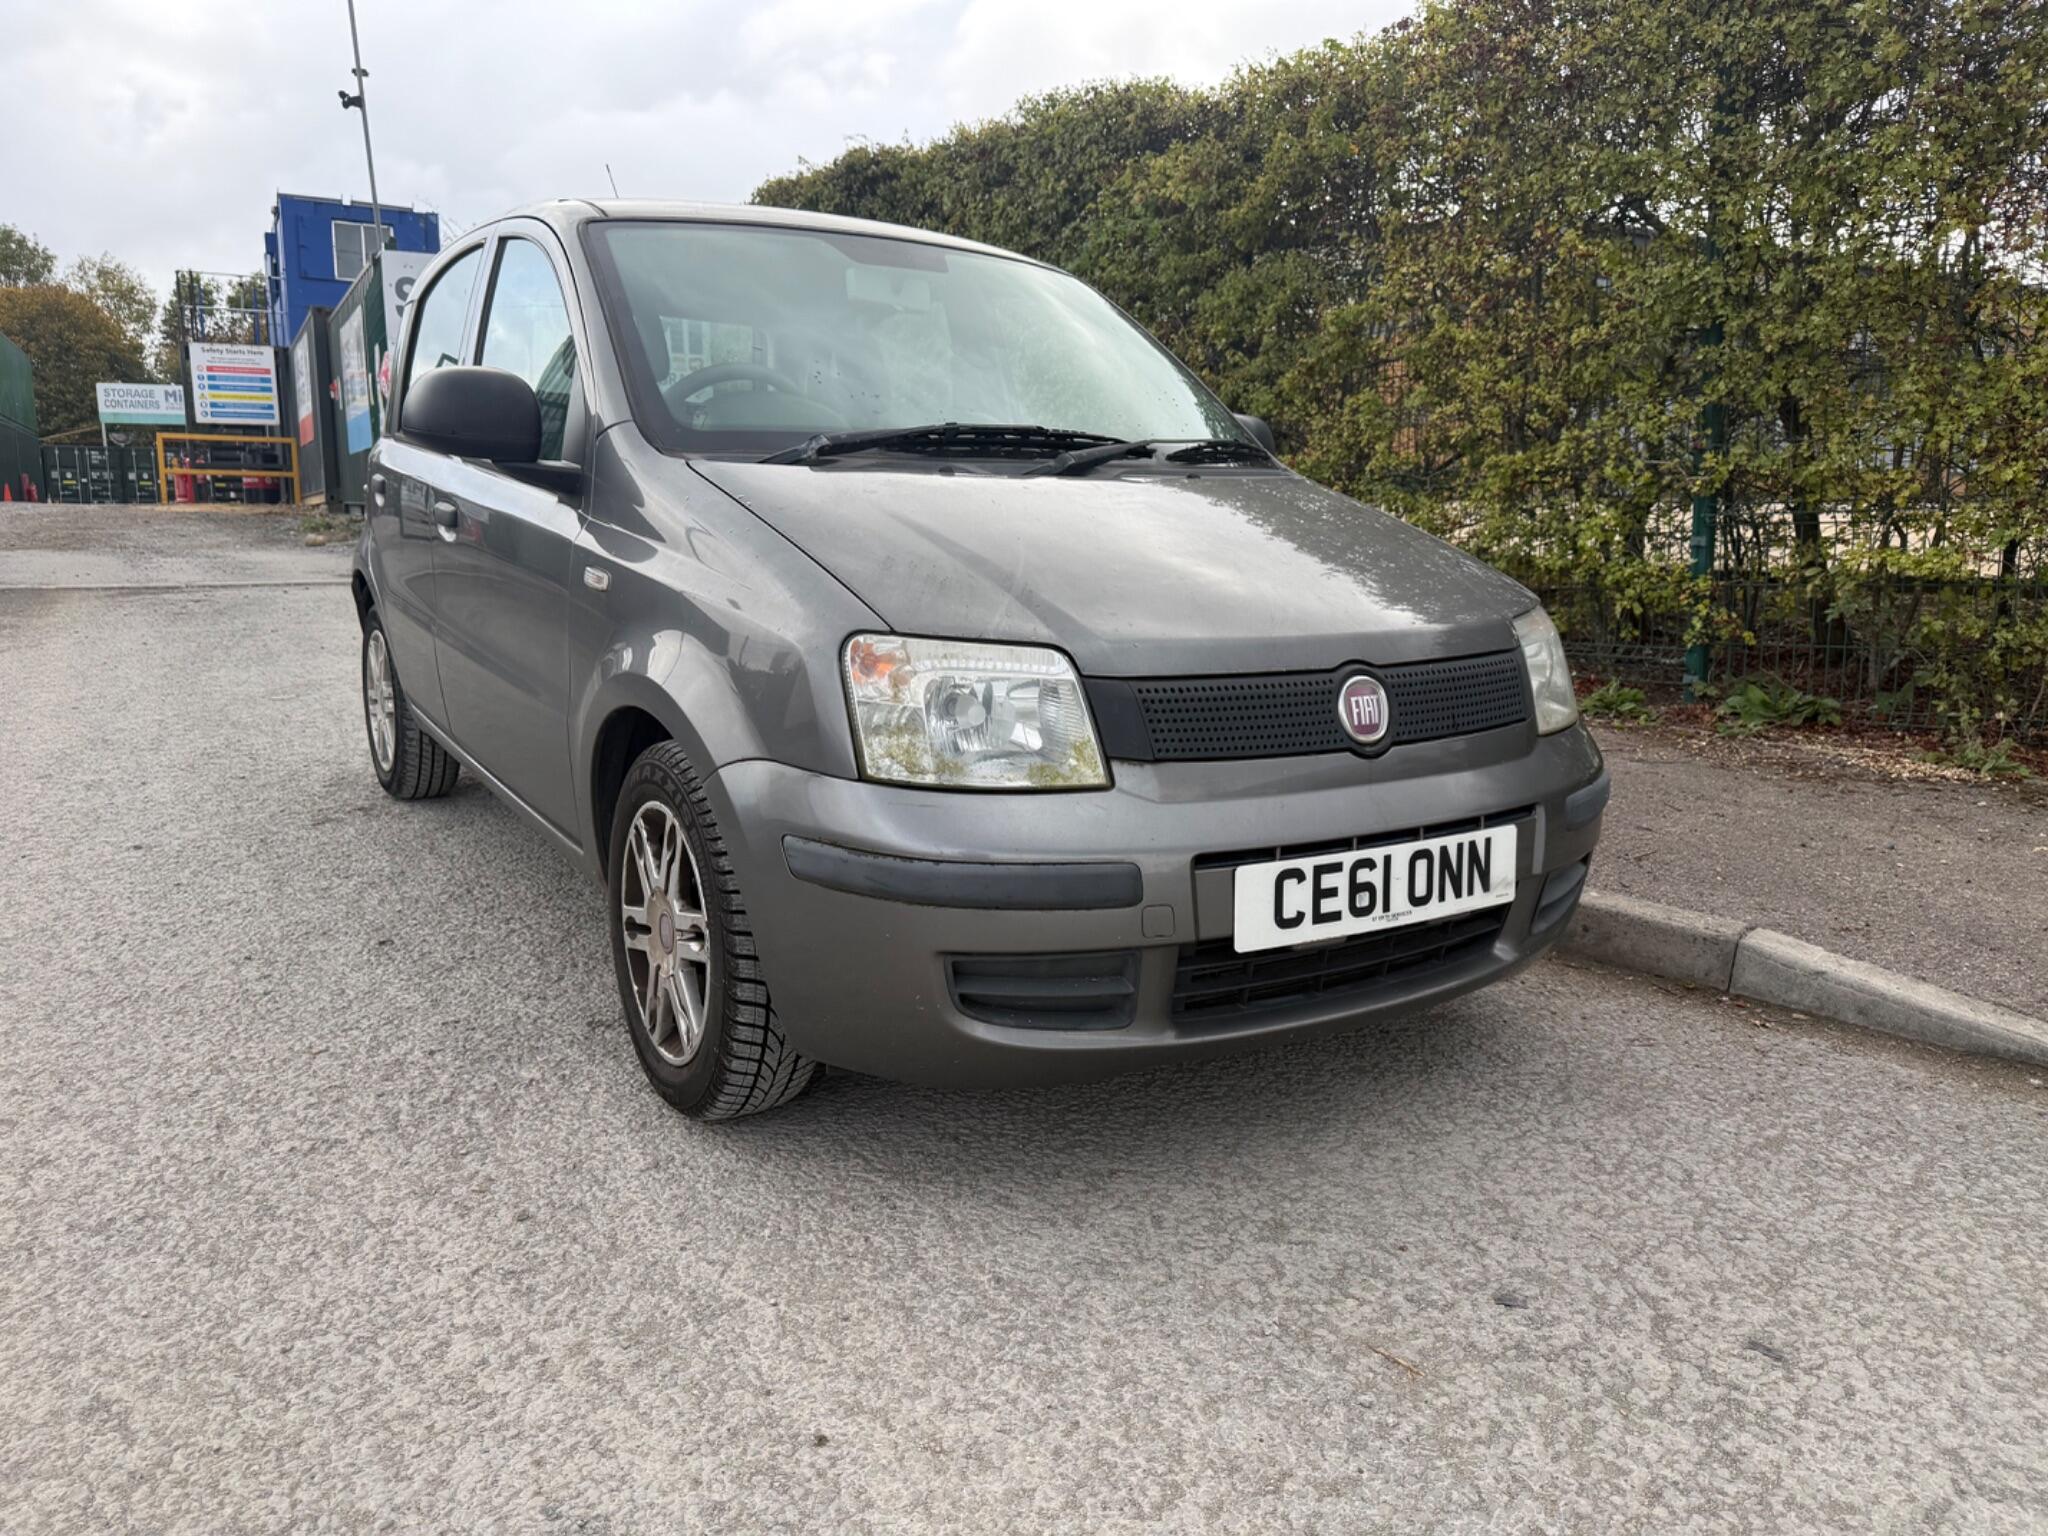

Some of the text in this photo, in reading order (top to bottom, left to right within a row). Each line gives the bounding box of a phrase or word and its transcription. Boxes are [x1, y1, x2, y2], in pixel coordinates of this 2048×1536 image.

[200, 346, 224, 355] Safety
[225, 347, 246, 355] Starts
[104, 388, 155, 399] STORAGE
[104, 399, 160, 410] CONTAINERS
[1350, 695, 1379, 726] FIAT
[1273, 836, 1492, 930] CE61 ONN
